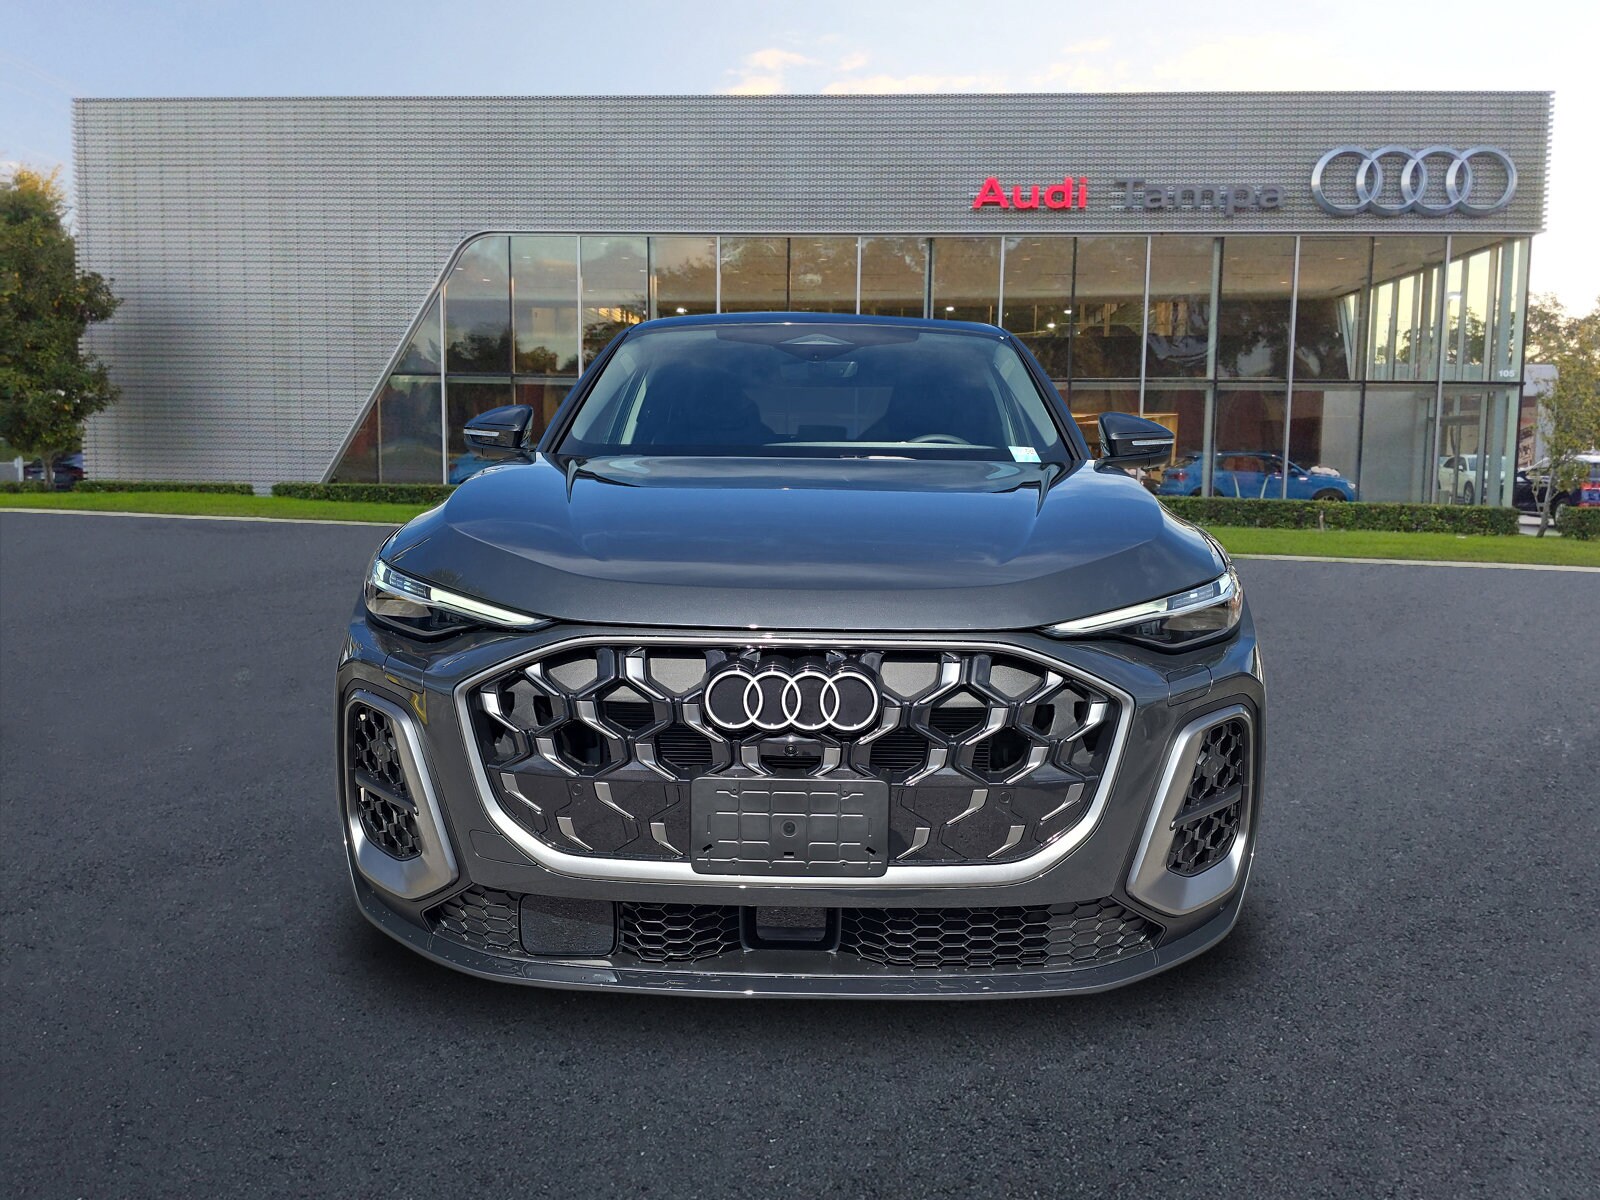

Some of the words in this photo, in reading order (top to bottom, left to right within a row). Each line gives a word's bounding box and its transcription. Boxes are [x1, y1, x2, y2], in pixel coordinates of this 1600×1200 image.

[972, 176, 1088, 209] Audi
[1113, 178, 1285, 217] Tampa
[1498, 369, 1515, 378] 105
